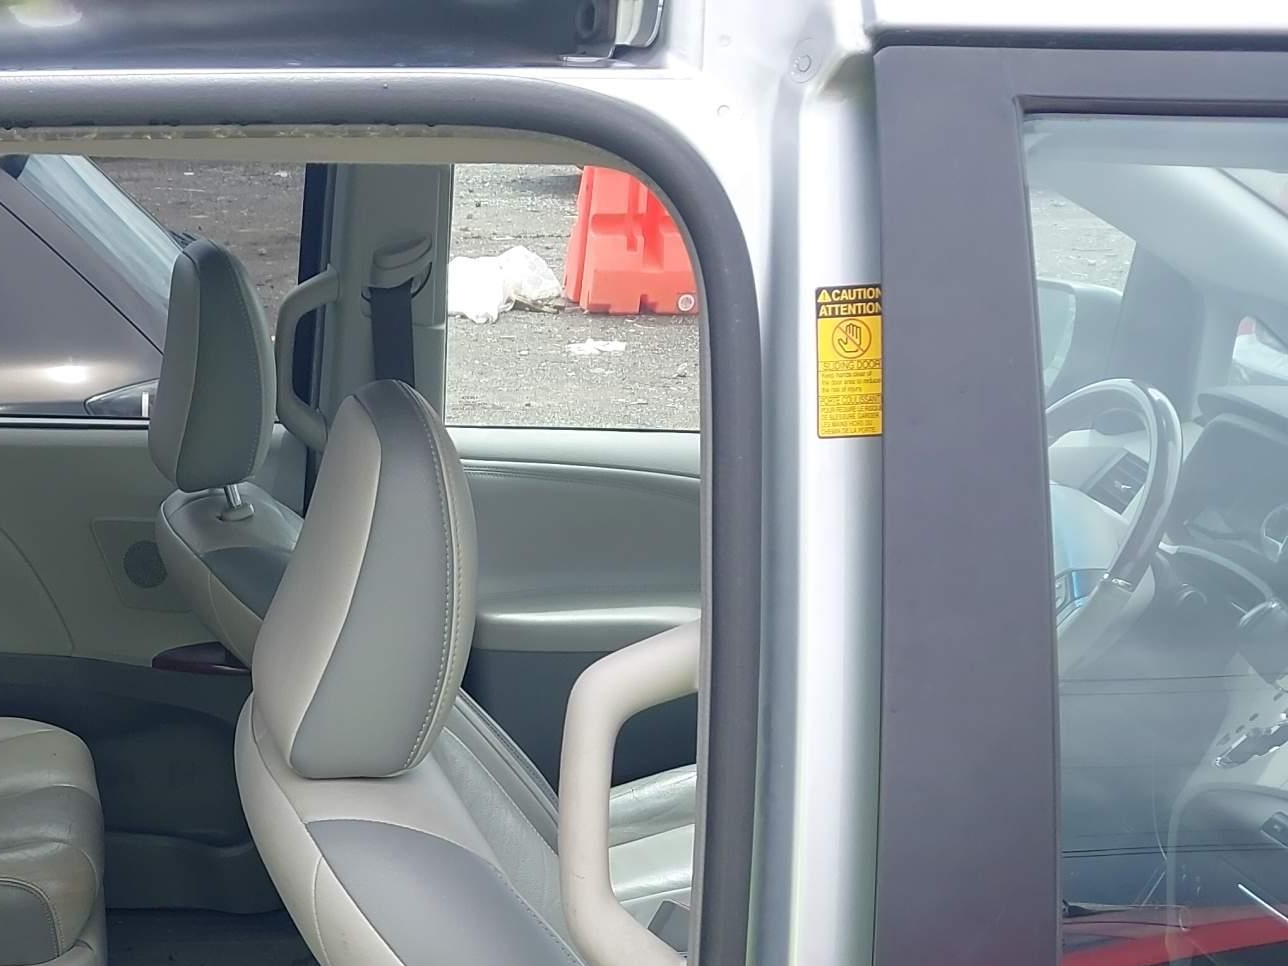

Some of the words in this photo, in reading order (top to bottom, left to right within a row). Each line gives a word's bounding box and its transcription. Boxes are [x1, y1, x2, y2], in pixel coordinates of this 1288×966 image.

[831, 288, 881, 301] CAUTION
[819, 302, 881, 316] ATTENTION
[857, 359, 881, 370] DOOR
